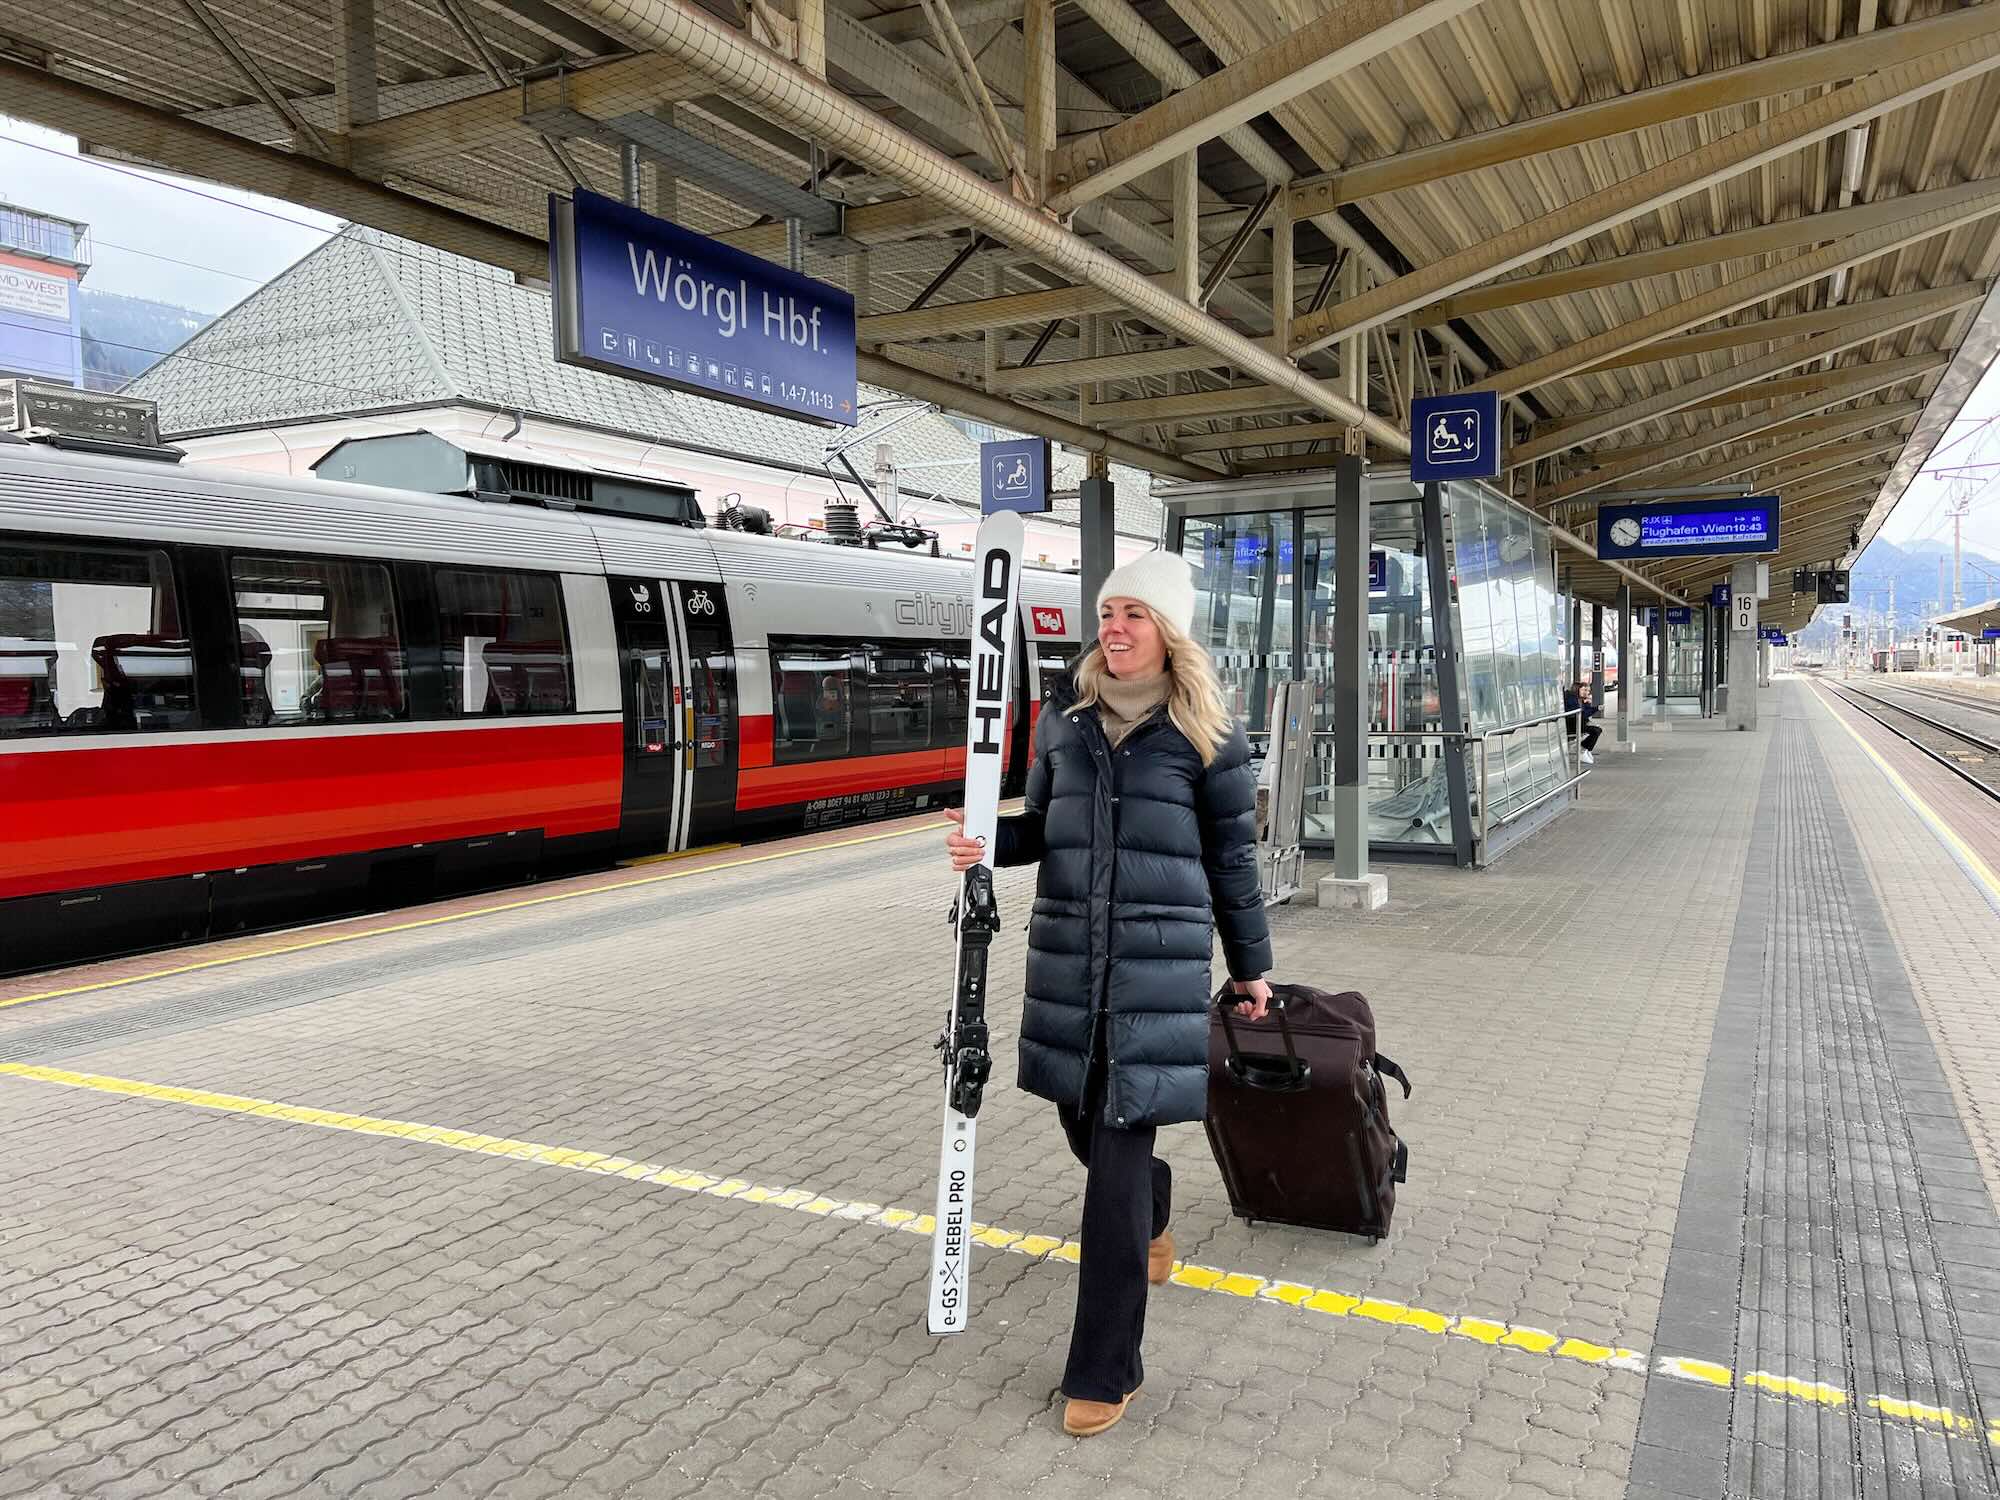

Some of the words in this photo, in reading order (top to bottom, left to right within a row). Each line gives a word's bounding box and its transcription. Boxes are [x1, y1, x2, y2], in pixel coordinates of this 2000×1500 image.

[627, 241, 748, 338] Wörgl
[762, 291, 828, 355] Hbf.
[1641, 516, 1661, 525] RJX
[1641, 525, 1699, 538] Flughafen
[1702, 523, 1733, 535] Wien
[895, 592, 973, 635] cityj
[1737, 596, 1752, 611] 16
[1739, 613, 1748, 627] 0
[973, 547, 1012, 755] HEAD
[949, 1169, 965, 1203] PRO
[945, 1207, 963, 1257] REBEL
[942, 1287, 958, 1326] e-GS
